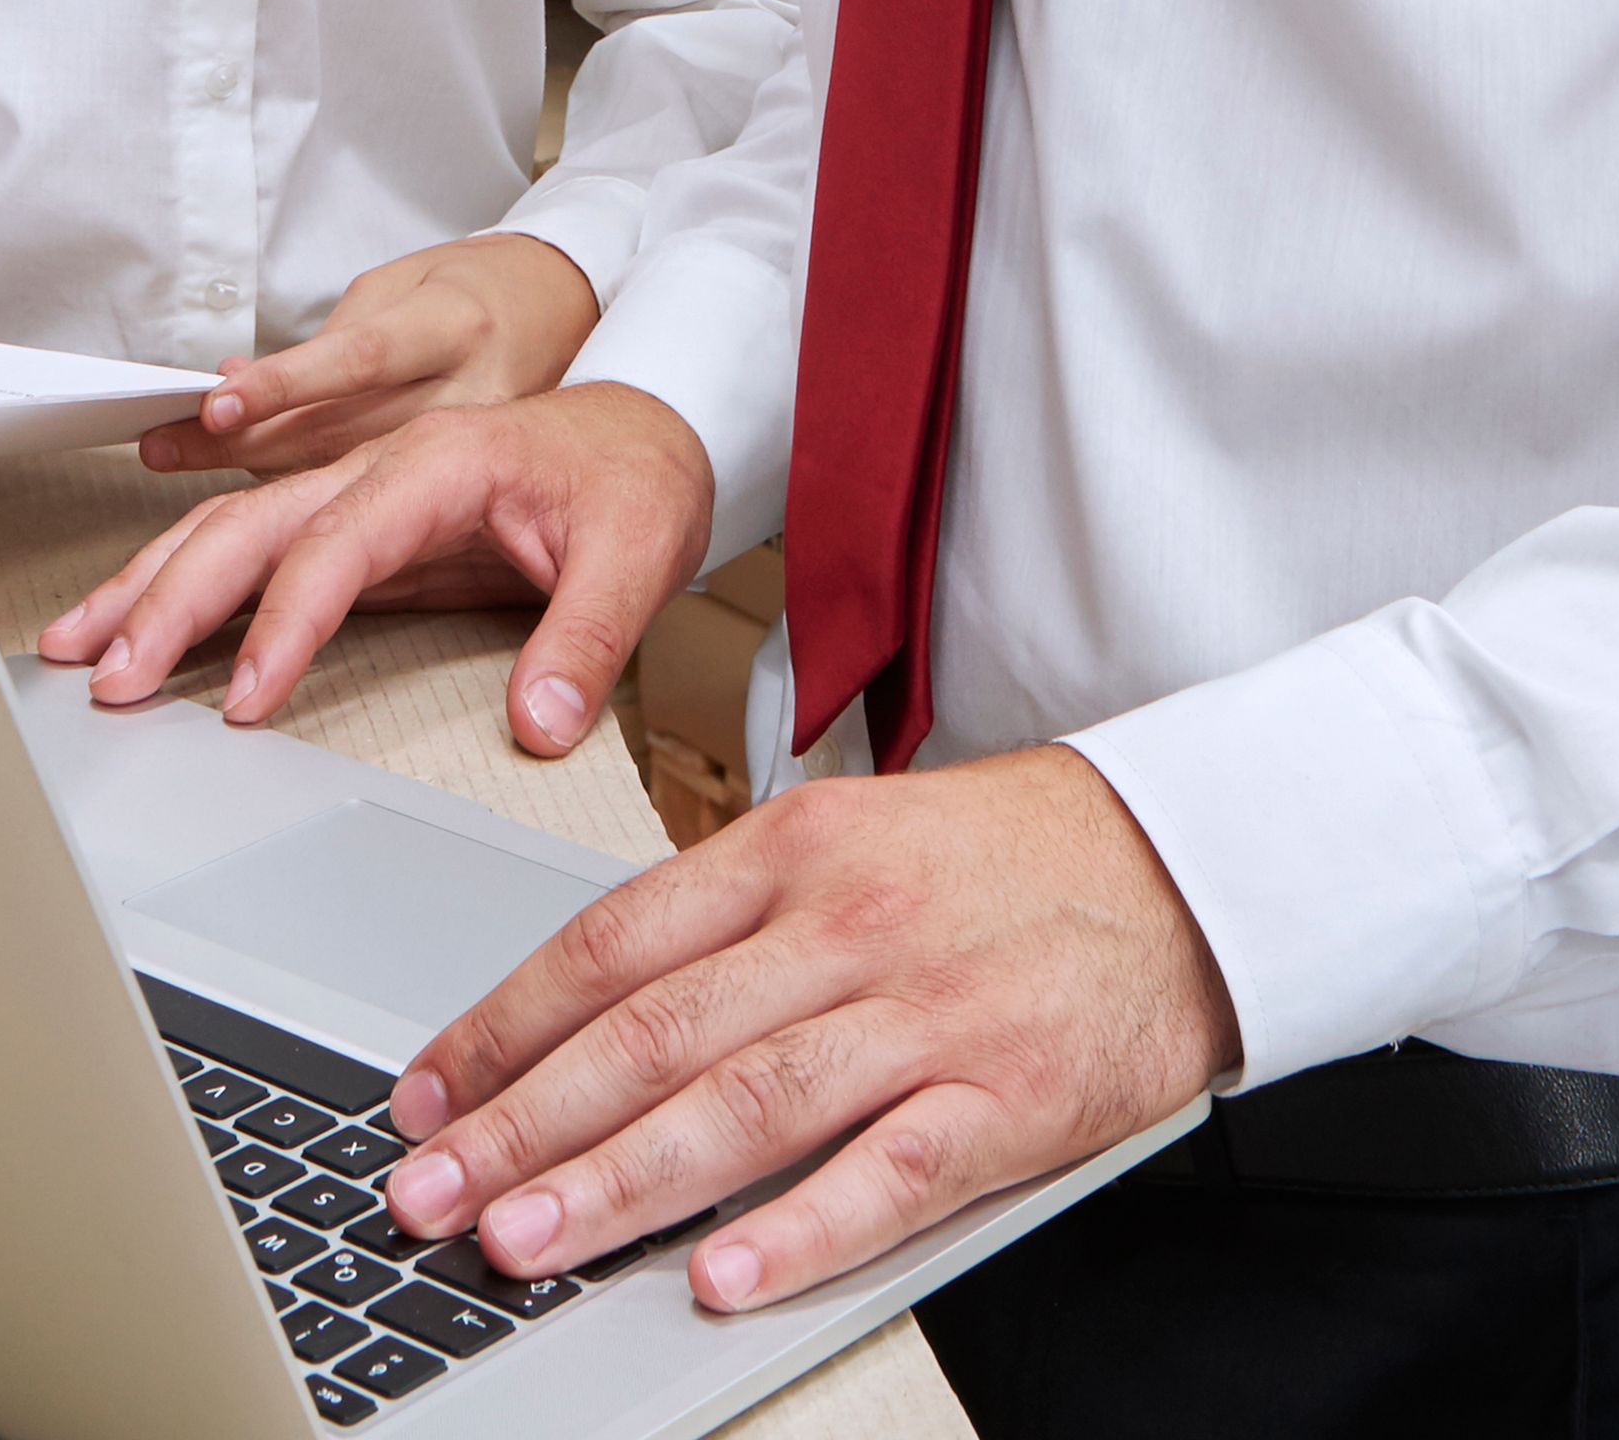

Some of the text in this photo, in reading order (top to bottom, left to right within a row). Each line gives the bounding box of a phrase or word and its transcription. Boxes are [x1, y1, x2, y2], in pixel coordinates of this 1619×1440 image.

[204, 1084, 227, 1100] V
[272, 1112, 296, 1126] C
[341, 1141, 368, 1157] X
[243, 1161, 267, 1176] D
[313, 1191, 336, 1207] S
[257, 1233, 288, 1252] W
[333, 1266, 358, 1283] Q
